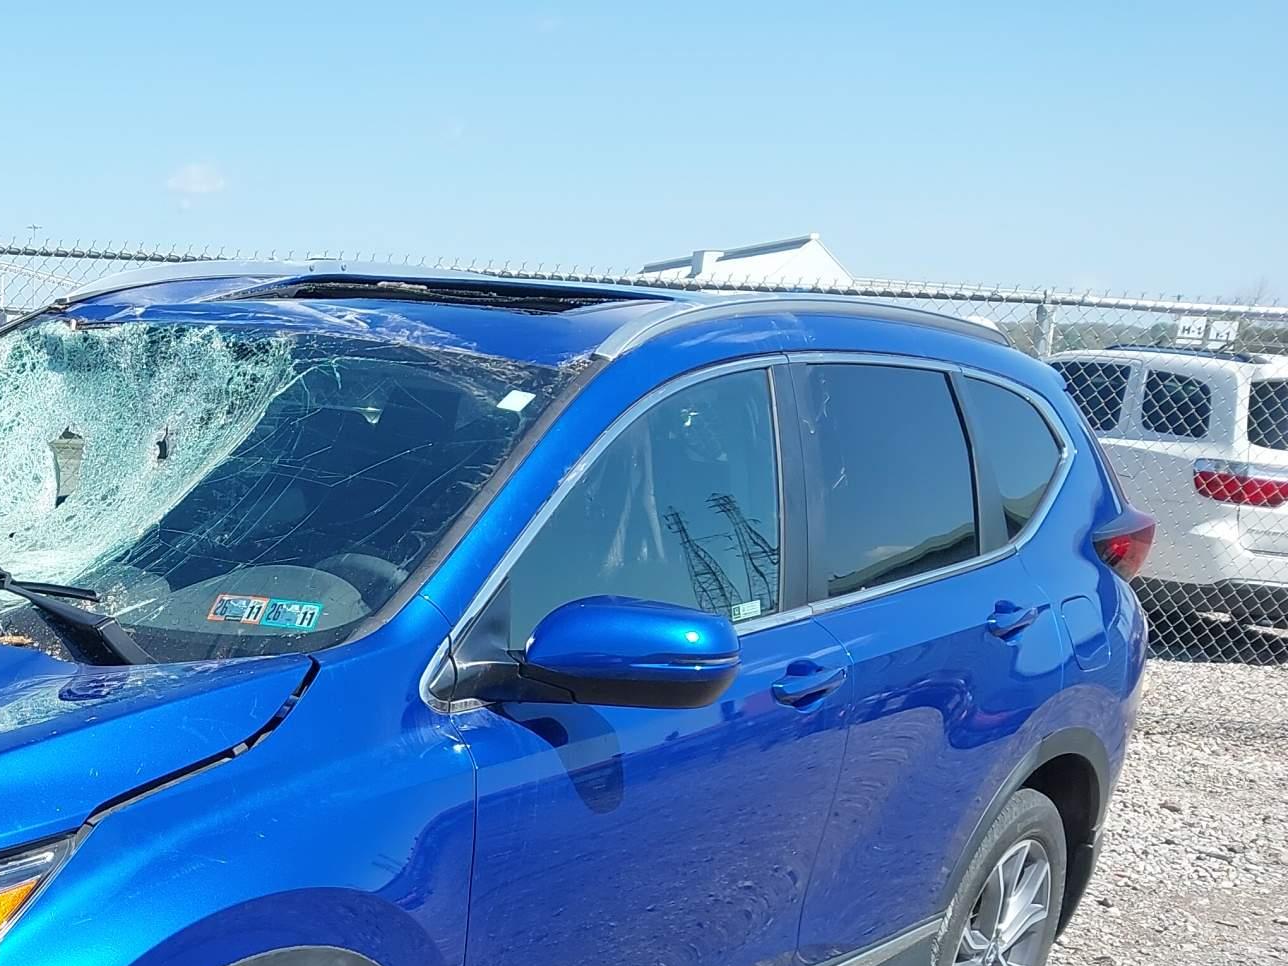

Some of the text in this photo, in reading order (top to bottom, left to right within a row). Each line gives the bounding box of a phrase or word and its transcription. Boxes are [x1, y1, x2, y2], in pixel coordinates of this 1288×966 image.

[245, 604, 263, 621] 11
[267, 603, 315, 627] 26 11
